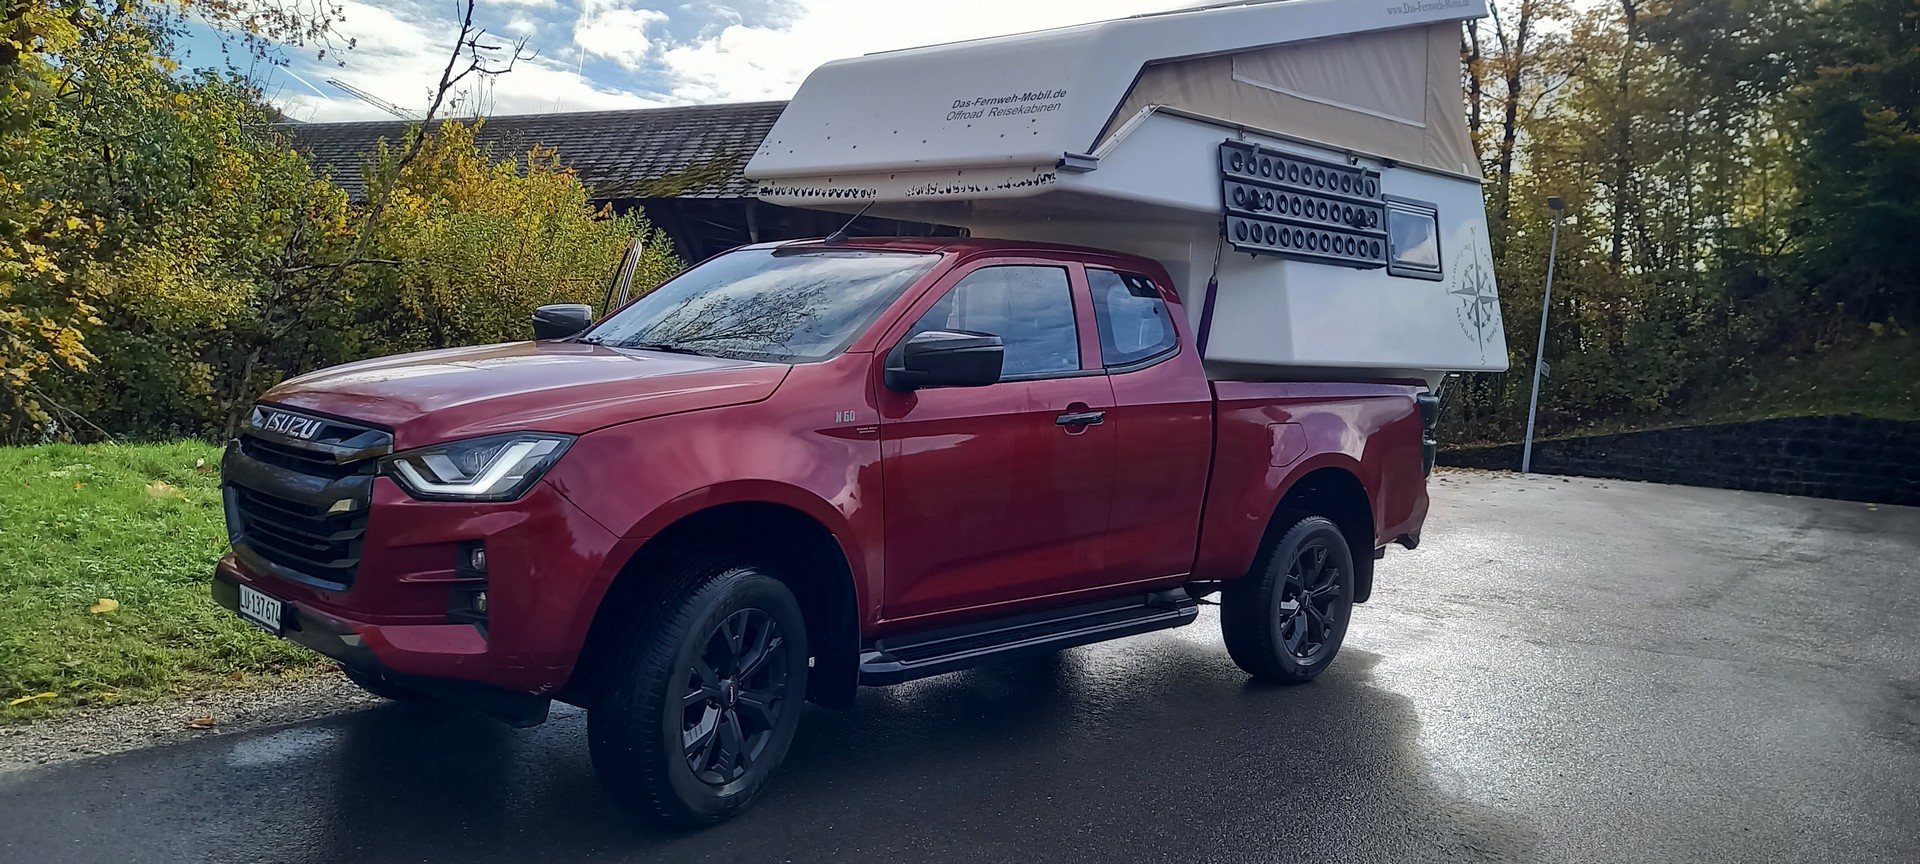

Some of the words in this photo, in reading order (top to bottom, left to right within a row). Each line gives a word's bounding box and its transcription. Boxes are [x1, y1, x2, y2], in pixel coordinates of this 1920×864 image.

[952, 89, 1067, 109] Das-Fernweh-Mobil.de
[946, 109, 984, 121] Offroad
[988, 102, 1062, 117] Reisekabinen
[264, 411, 322, 439] ISUZU
